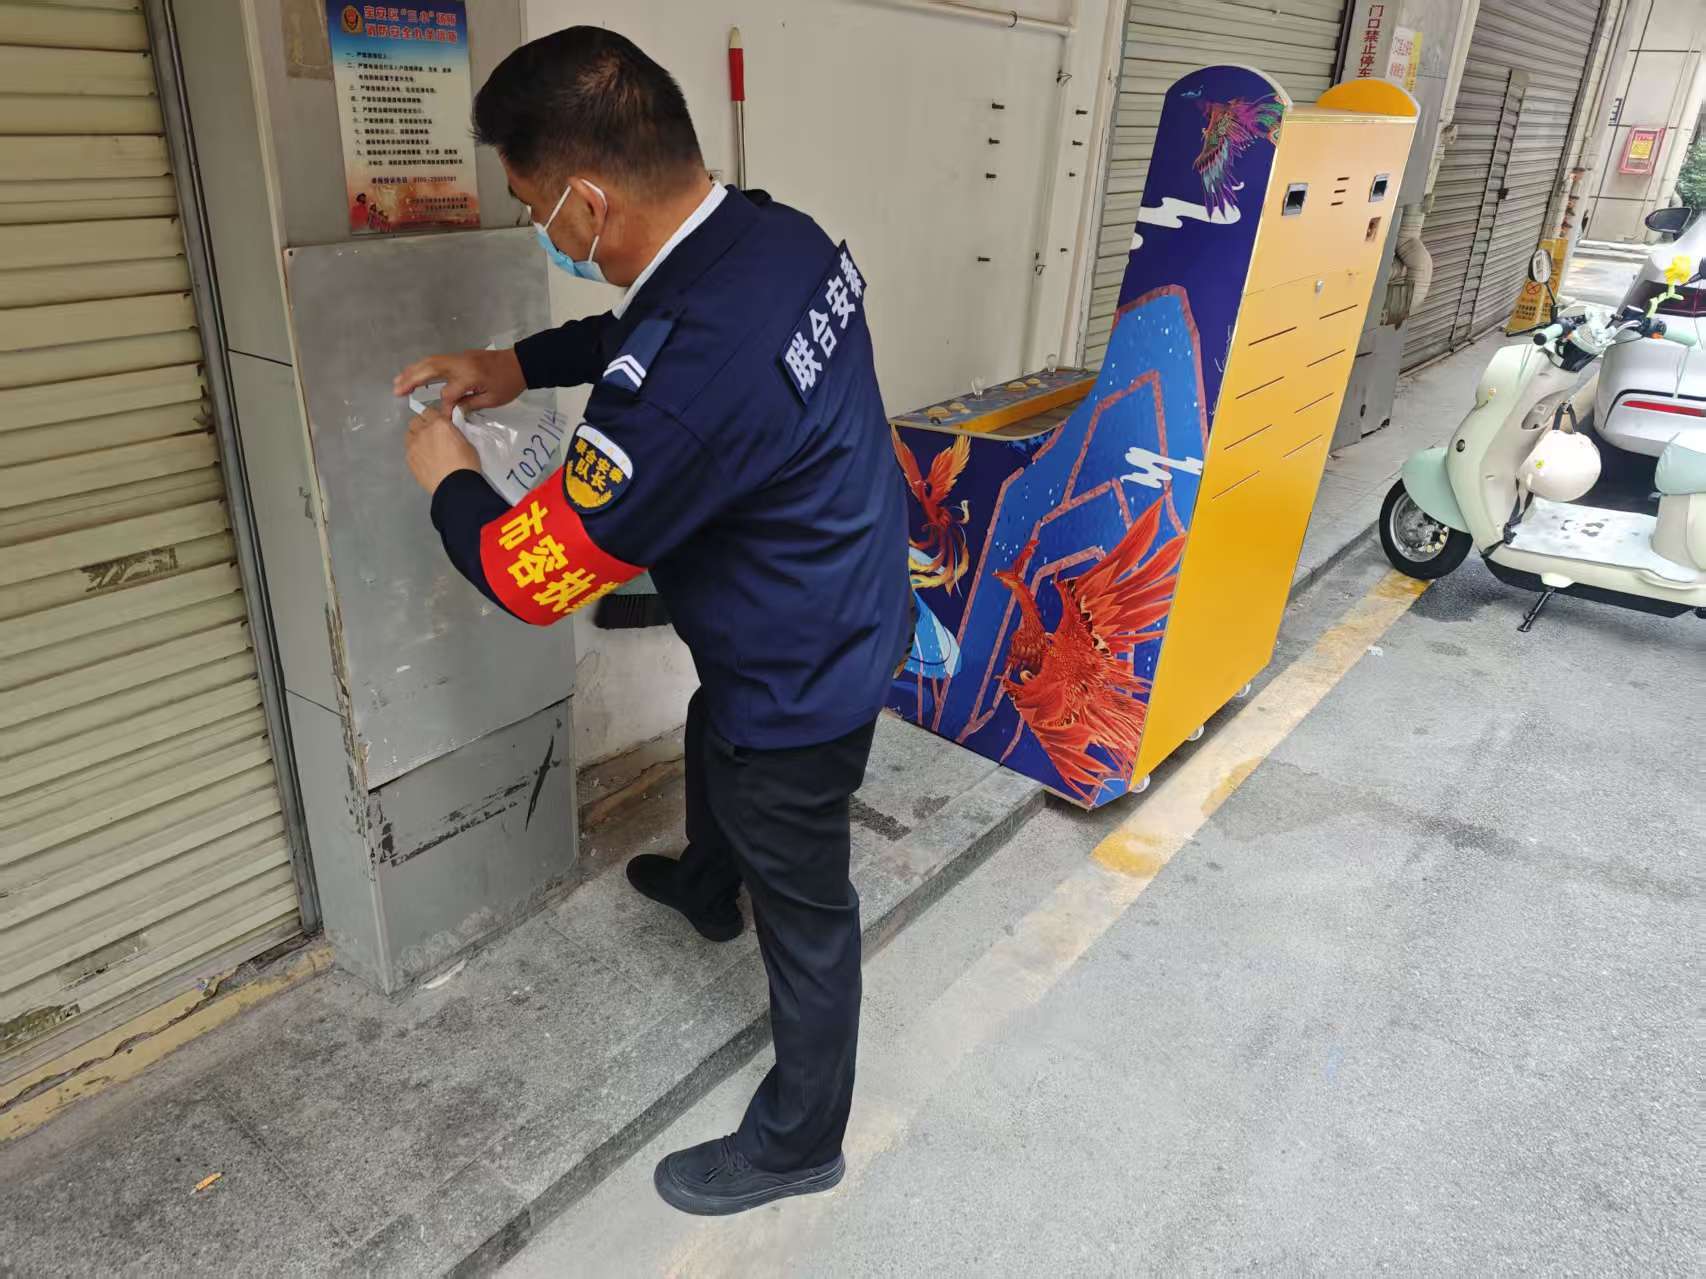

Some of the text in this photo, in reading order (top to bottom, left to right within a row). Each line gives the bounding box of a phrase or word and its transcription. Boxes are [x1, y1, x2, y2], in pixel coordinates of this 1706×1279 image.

[1356, 4, 1384, 79] 门口禁止停车
